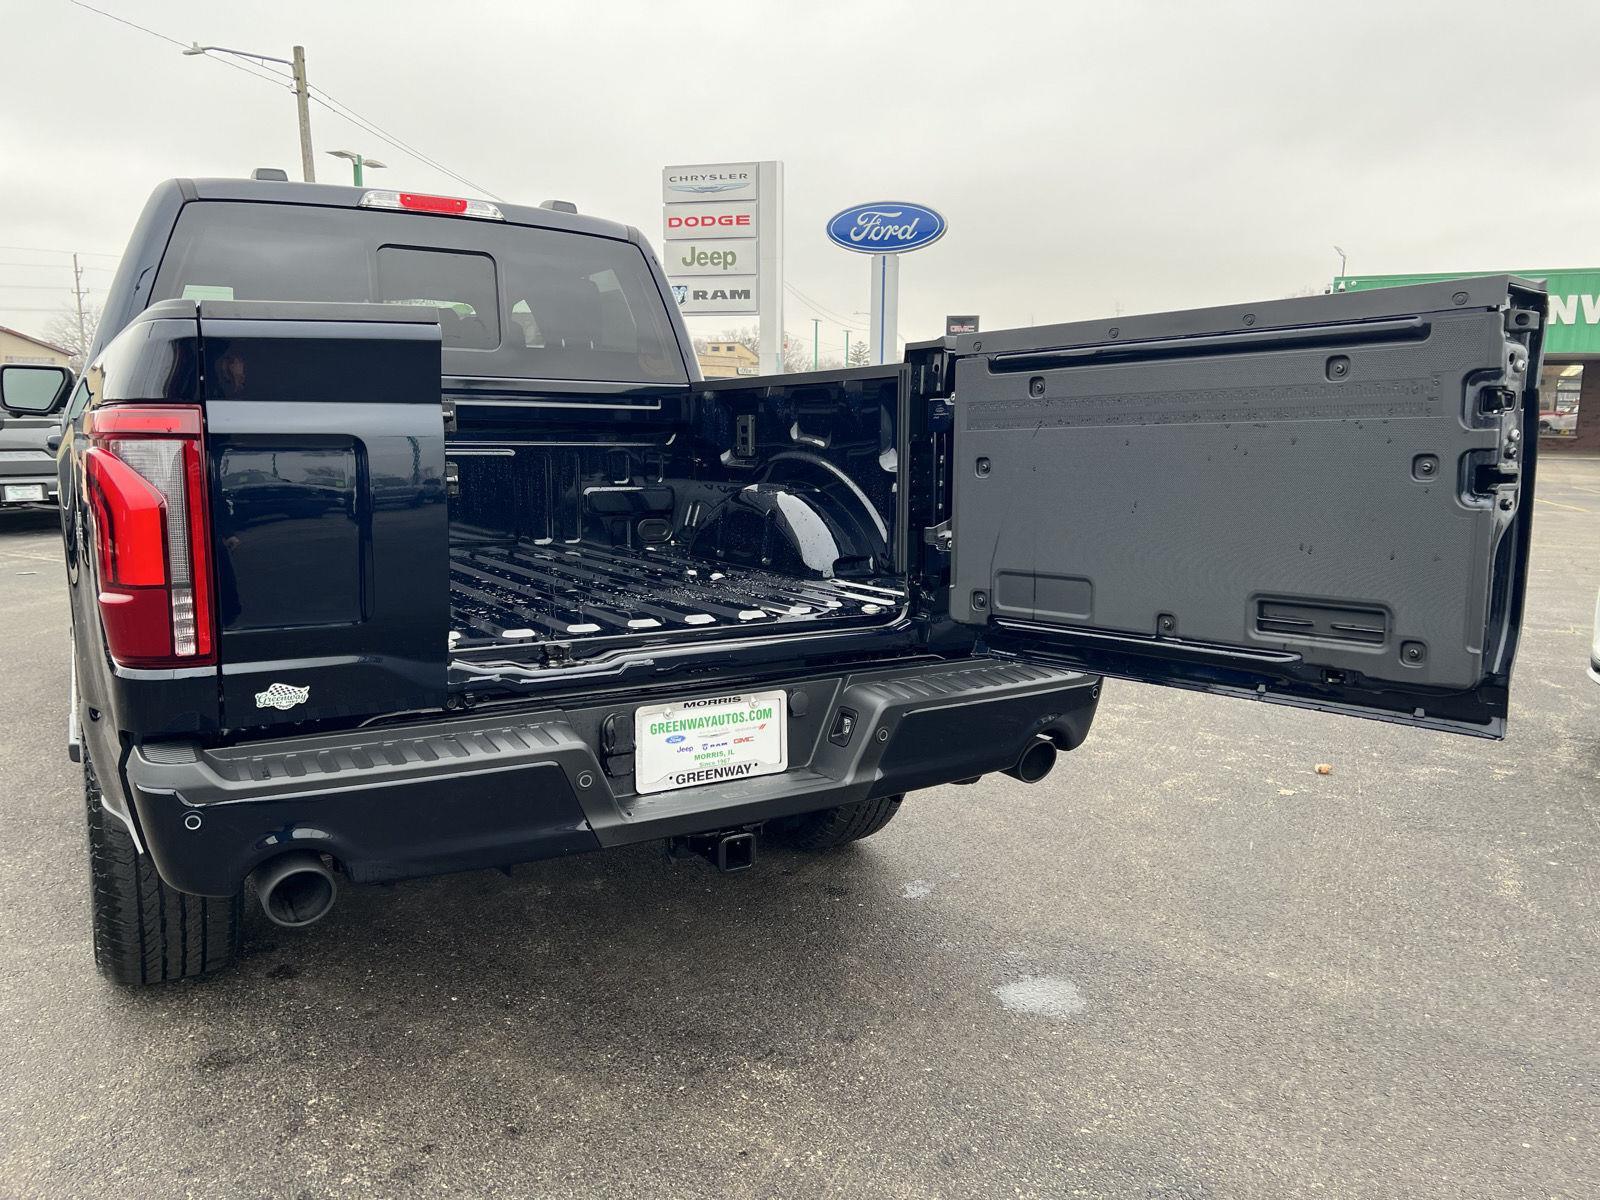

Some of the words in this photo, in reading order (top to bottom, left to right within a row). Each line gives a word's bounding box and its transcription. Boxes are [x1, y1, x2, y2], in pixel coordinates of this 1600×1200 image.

[669, 173, 748, 182] CHRYSLER
[668, 215, 751, 228] DODGE
[850, 211, 920, 242] Ford
[682, 246, 737, 270] Jeep
[692, 289, 751, 300] RAM
[683, 696, 742, 709] MORRIS
[650, 707, 773, 735] GREENWAYAUTOS.COM
[733, 736, 754, 745] GMC
[676, 745, 694, 753] Jeep
[694, 750, 726, 761] MORRIS,
[675, 763, 752, 785] GREENWAY
